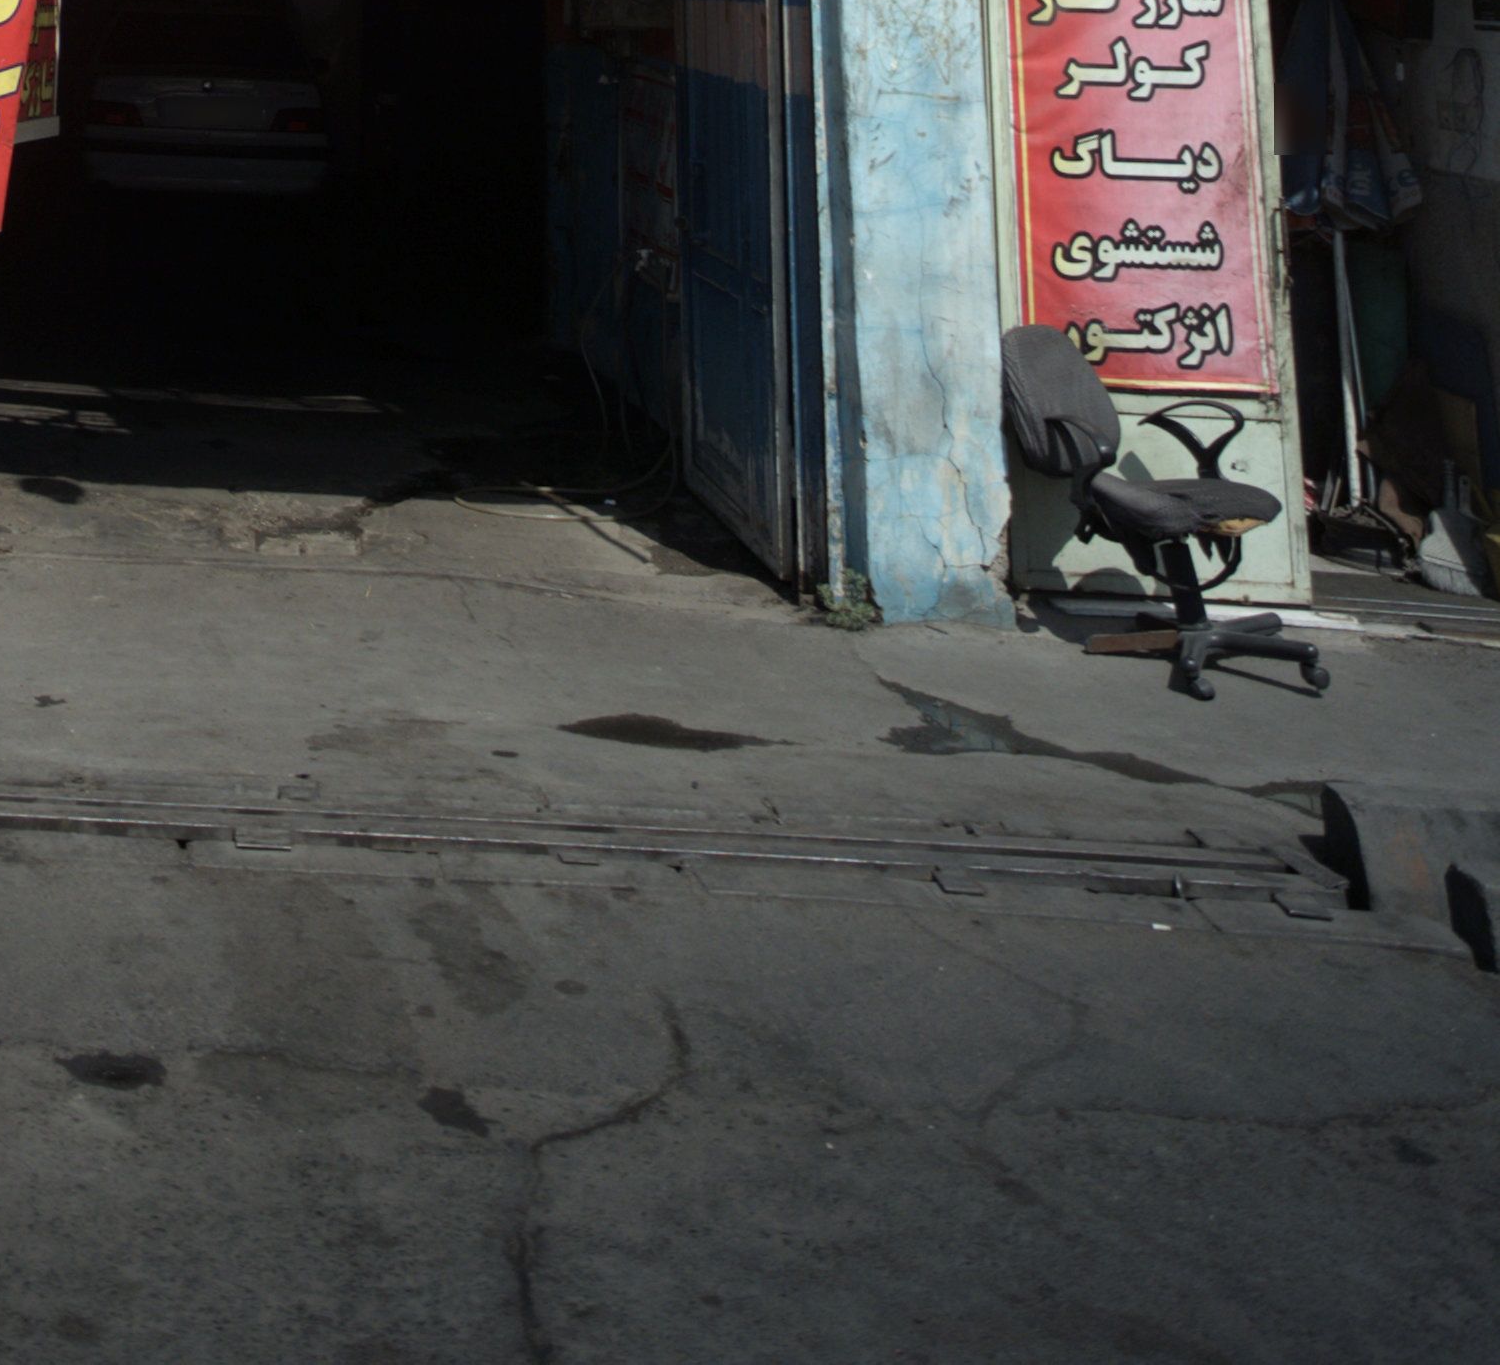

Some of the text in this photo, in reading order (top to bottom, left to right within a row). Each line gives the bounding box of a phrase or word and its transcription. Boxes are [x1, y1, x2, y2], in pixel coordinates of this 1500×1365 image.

[1055, 35, 1211, 101] کولر
[1049, 128, 1223, 194] دیاگ
[1052, 218, 1224, 282] شستشوی
